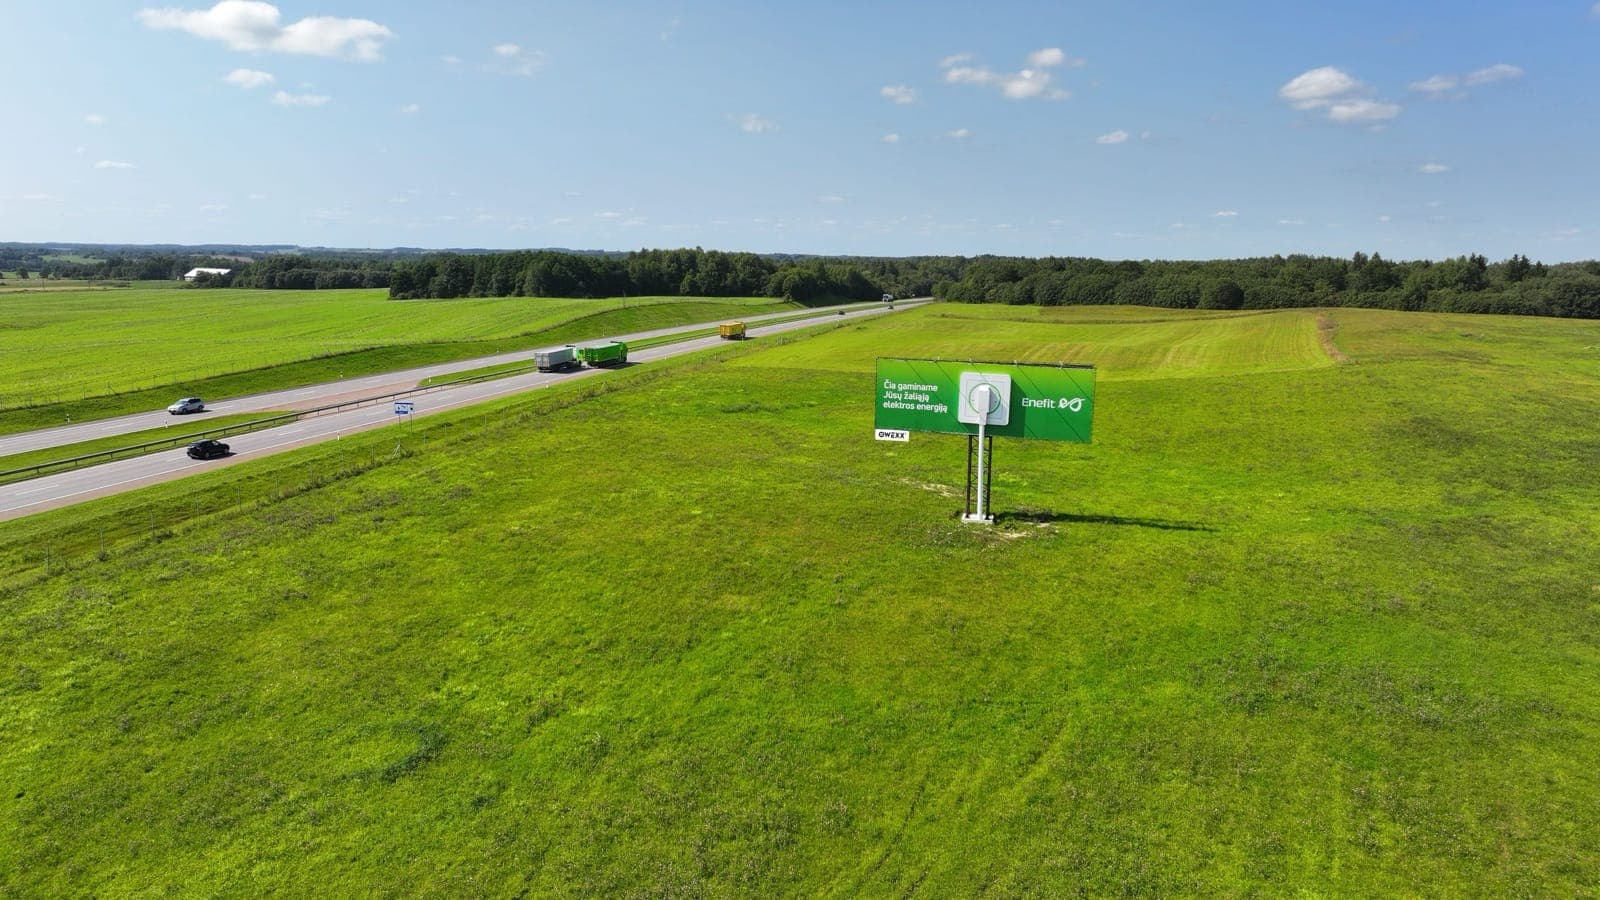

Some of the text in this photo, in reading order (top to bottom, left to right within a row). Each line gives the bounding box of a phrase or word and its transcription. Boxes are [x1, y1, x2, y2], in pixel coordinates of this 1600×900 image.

[883, 379, 938, 391] Čia gaminame
[883, 391, 930, 402] Jūsų žaliąją
[883, 401, 948, 413] elektros energiją
[1021, 397, 1056, 409] Enefit
[878, 431, 905, 439] OWEXX
